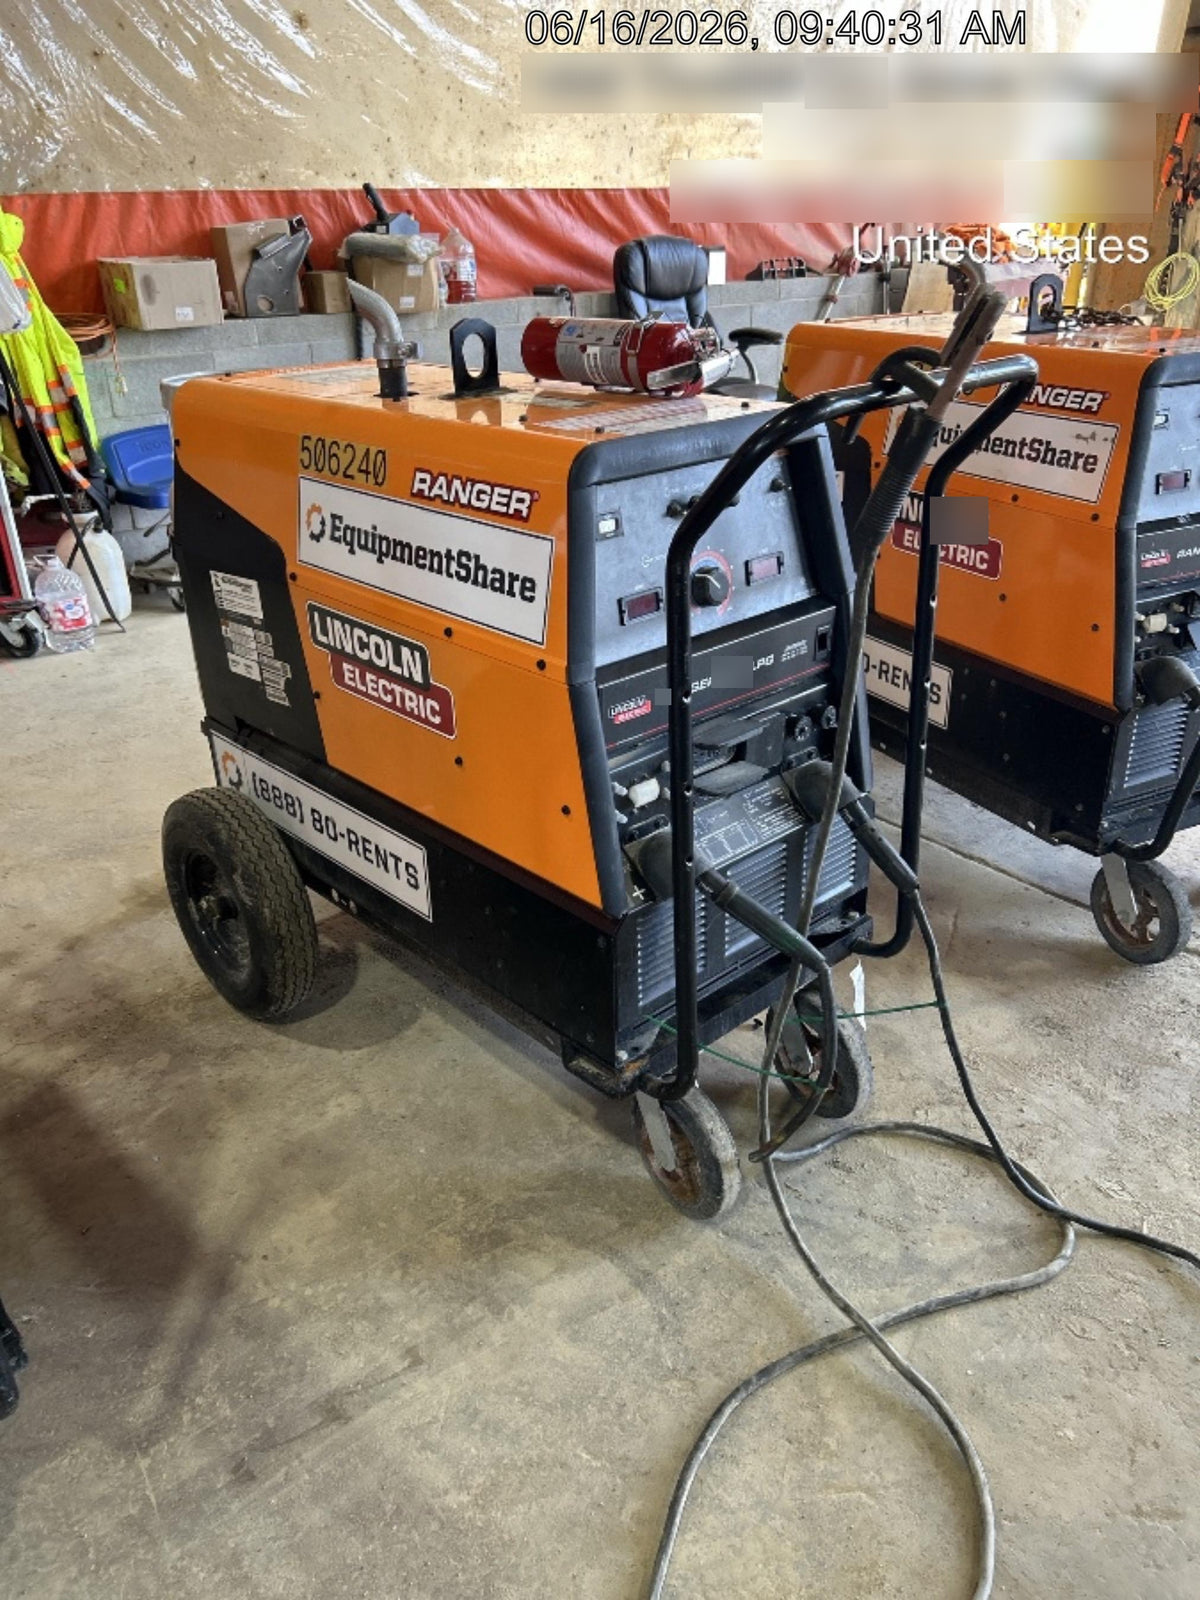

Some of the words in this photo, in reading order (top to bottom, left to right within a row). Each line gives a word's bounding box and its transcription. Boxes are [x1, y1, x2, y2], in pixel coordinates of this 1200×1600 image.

[300, 434, 387, 486] 506240
[412, 471, 531, 518] RANGER
[330, 513, 537, 603] EquipmentShare
[313, 611, 424, 684] LINCOLN
[342, 662, 442, 725] ELECTRIC
[252, 771, 305, 824] (888)
[310, 807, 420, 891] 80-RENTS
